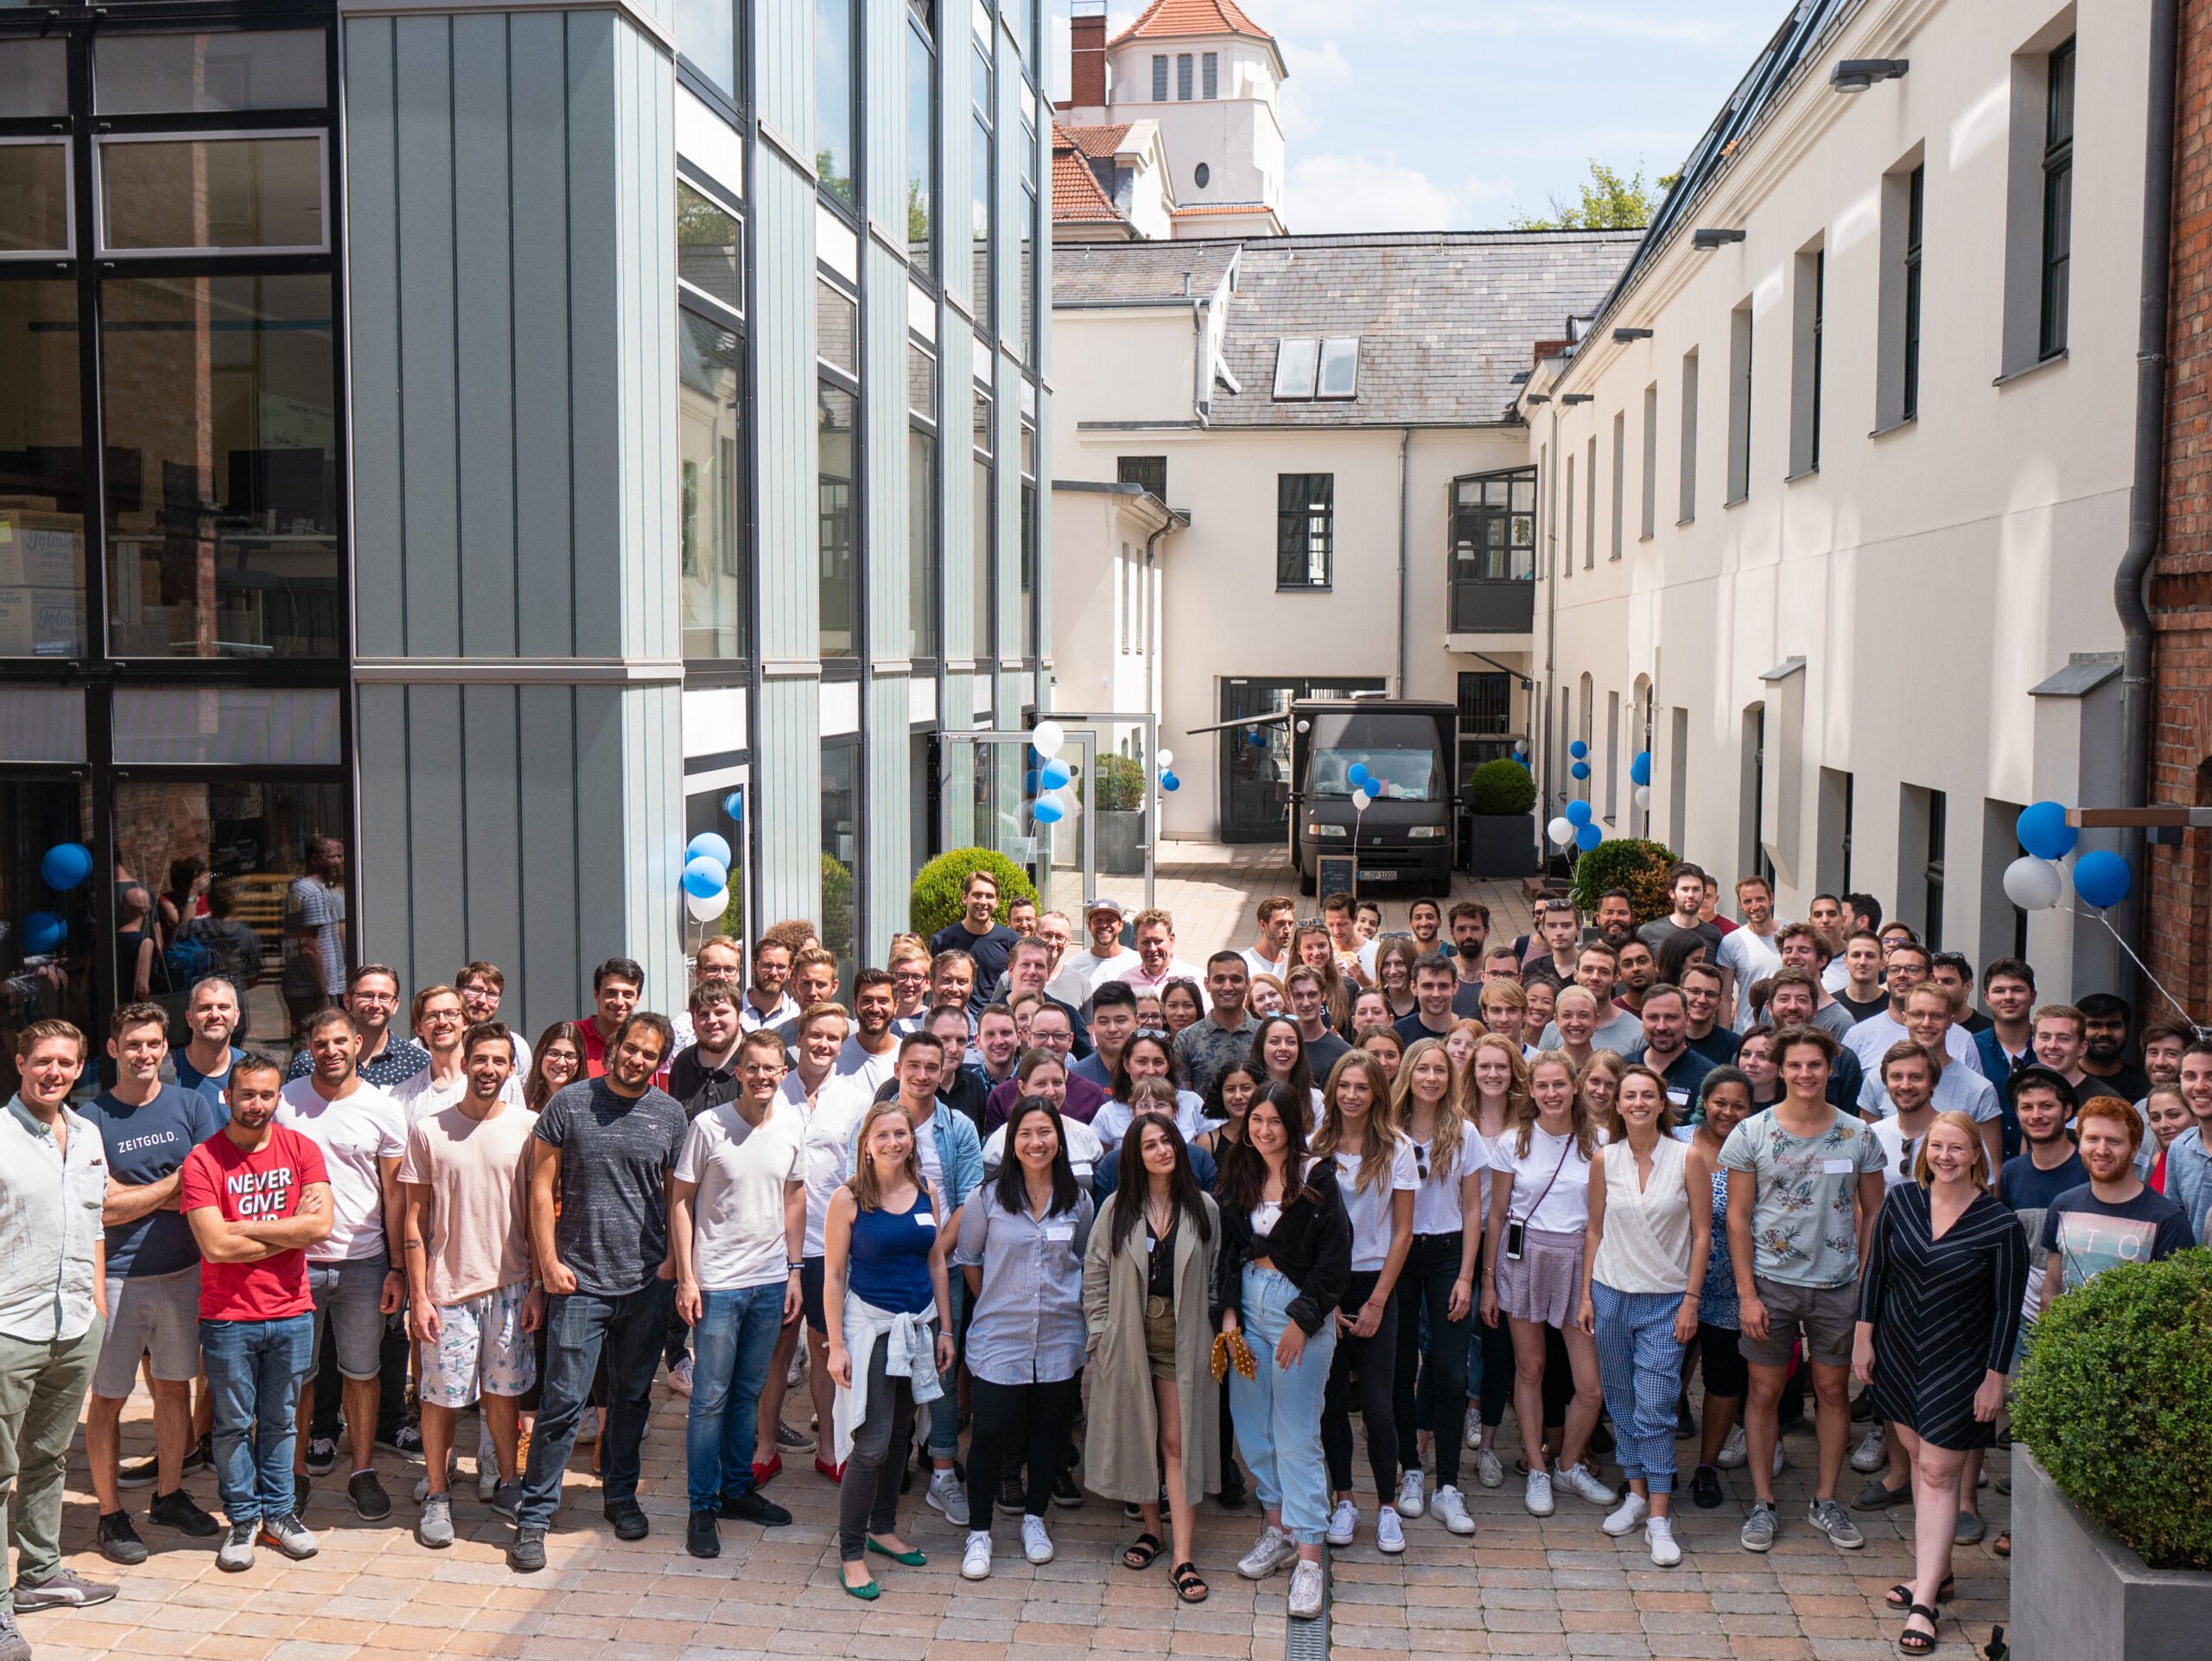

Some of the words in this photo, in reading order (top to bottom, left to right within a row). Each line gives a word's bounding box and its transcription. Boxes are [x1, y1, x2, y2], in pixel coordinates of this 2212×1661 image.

[118, 1130, 179, 1154] ZEITGOLD.
[227, 1168, 293, 1195] NEVER
[238, 1190, 287, 1216] GIVE
